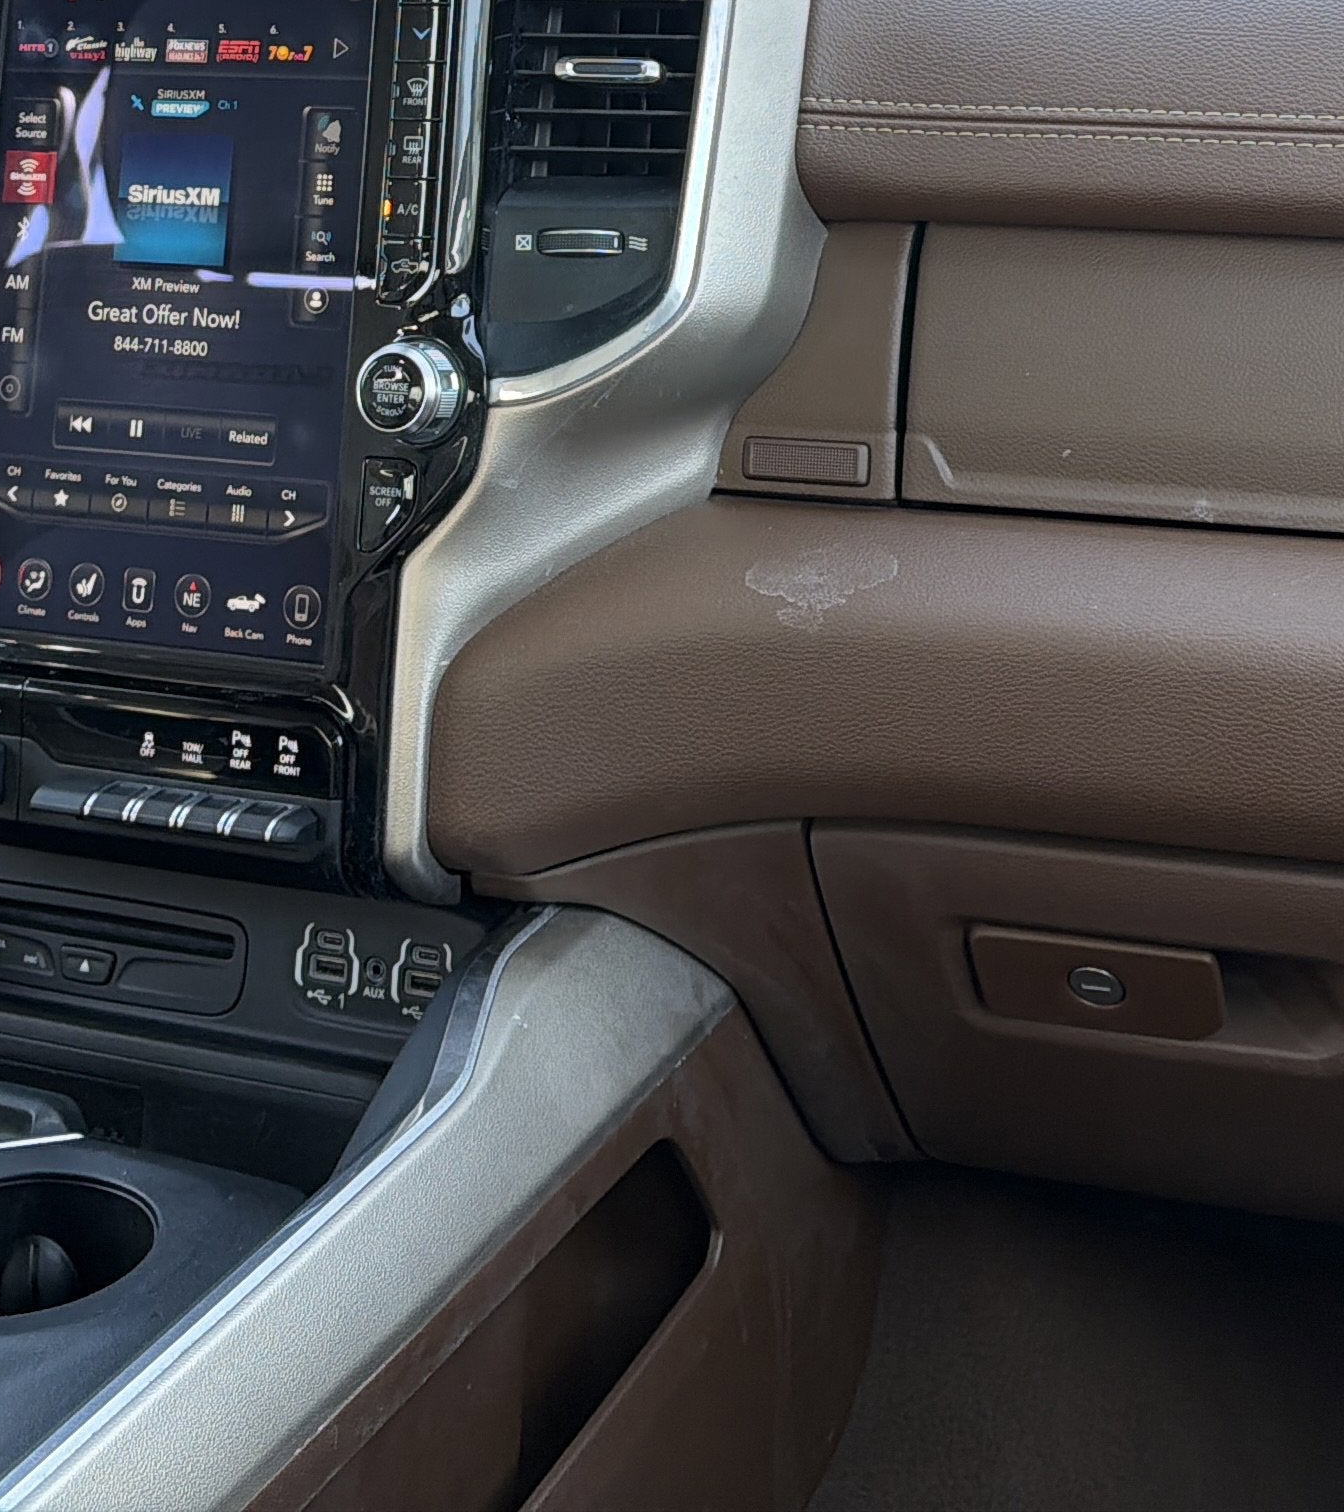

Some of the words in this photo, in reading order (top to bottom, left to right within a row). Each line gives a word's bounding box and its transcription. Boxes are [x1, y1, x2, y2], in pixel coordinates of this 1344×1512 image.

[17, 20, 25, 30] 1.
[67, 21, 76, 31] 2.
[116, 21, 126, 32] 3.
[166, 23, 176, 33] 4.
[218, 24, 227, 34] 5.
[269, 24, 279, 35] 6.
[218, 40, 261, 53] ESPN
[114, 43, 157, 63] highway
[402, 97, 428, 106] FRONT
[155, 101, 203, 115] PREVIEW
[18, 111, 47, 124] Select
[15, 127, 48, 139] Source
[314, 143, 341, 156] Notify
[401, 155, 423, 164] REAR
[127, 184, 221, 206] SiriusXM
[312, 194, 335, 206] Tune
[396, 203, 419, 216] A/C
[305, 251, 336, 263] Search
[5, 274, 30, 290] AM
[132, 277, 151, 290] XM
[155, 277, 201, 294] Preview
[87, 300, 138, 324] Great
[142, 303, 188, 326] Offer
[193, 306, 241, 330] Now!
[1, 327, 25, 344] FM
[113, 336, 208, 357] 844-711-8800
[372, 380, 409, 392] BROWSE
[376, 393, 405, 404] ENTER
[181, 426, 203, 439] LIVE
[228, 430, 269, 445] Related
[7, 465, 22, 477] CH
[44, 468, 82, 483] Favorites
[105, 474, 119, 486] For
[120, 475, 138, 487] You
[156, 478, 203, 494] Categories
[226, 484, 252, 497] Audio
[281, 490, 297, 501] CH
[369, 486, 402, 497] SCREEN
[375, 498, 392, 507] OFF
[182, 592, 201, 608] NE
[17, 604, 47, 617] Climate
[67, 610, 100, 622] Controls
[125, 616, 147, 628] Apps
[181, 622, 198, 633] Nav
[224, 627, 243, 638] Back
[244, 629, 265, 640] Cam
[286, 633, 313, 646] Phone
[139, 748, 156, 758] OFF
[182, 741, 204, 754] TOW/
[232, 748, 249, 758] OFF
[181, 753, 204, 765] HAUL
[229, 759, 252, 770] REAR
[279, 754, 296, 765] OFF
[273, 765, 301, 777] FRONT
[362, 986, 386, 1000] AUX
[337, 992, 345, 1010] 1
